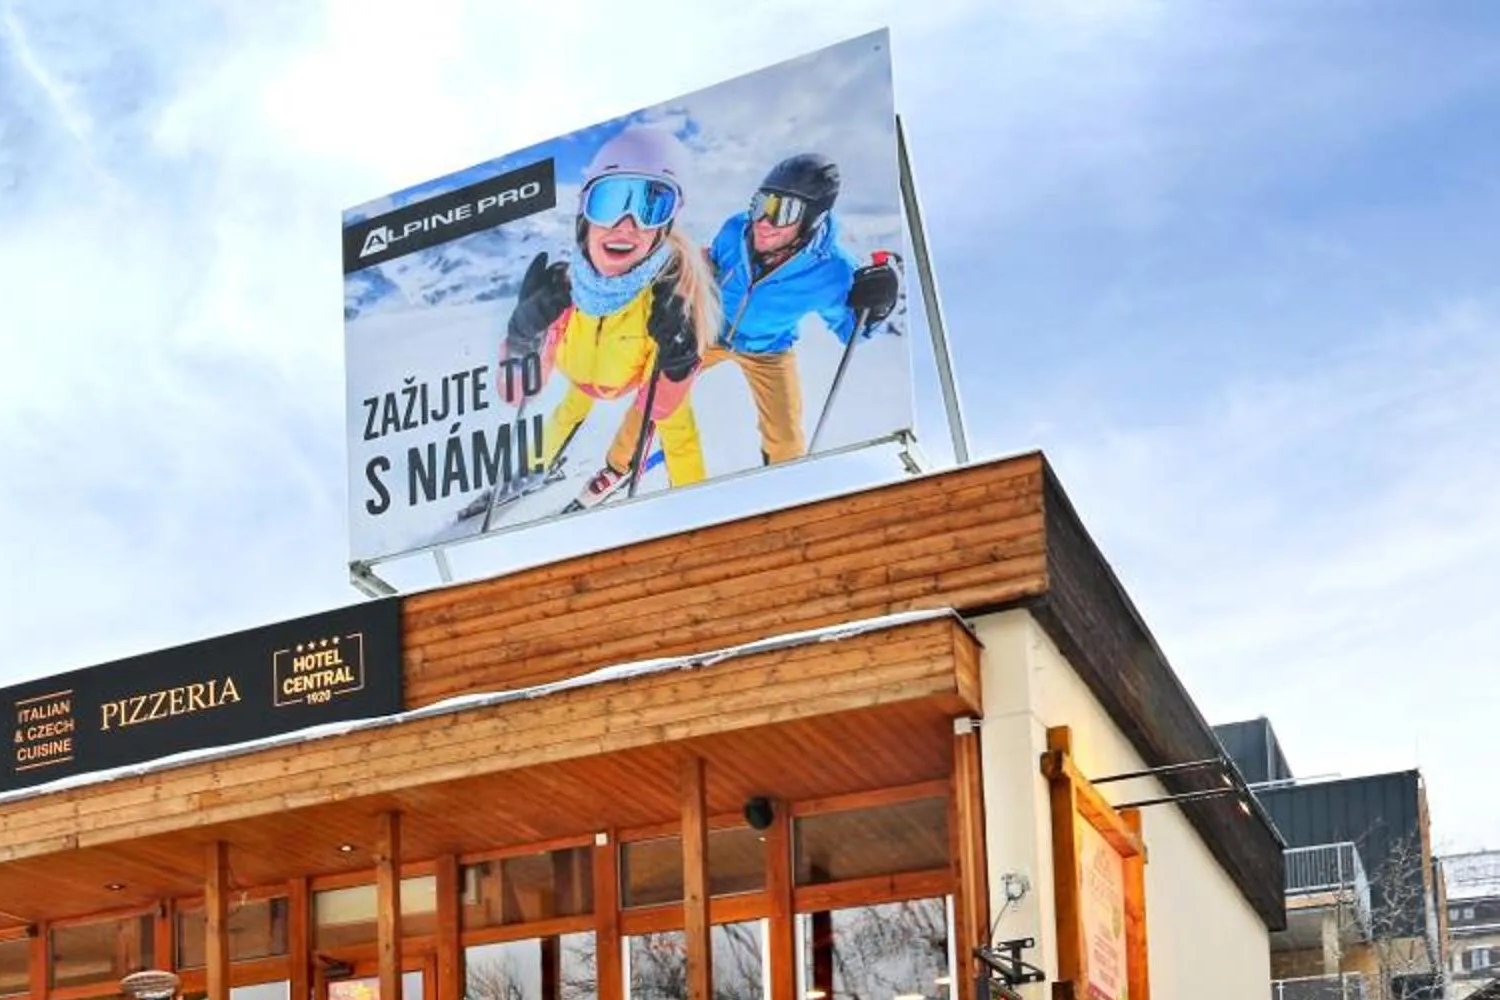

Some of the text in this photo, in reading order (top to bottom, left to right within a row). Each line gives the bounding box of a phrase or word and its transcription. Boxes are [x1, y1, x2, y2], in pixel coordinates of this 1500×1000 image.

[359, 181, 541, 258] ALPINE PRO
[363, 352, 542, 440] ZAŽIJTE TO
[366, 414, 545, 515] S NÁMI!
[293, 648, 343, 673] HOTEL
[283, 666, 355, 695] CENTRAL
[18, 699, 71, 724] ITALIAN
[100, 677, 240, 731] PIZZERIA
[27, 718, 75, 741] CZECH
[17, 738, 72, 761] CUISINE
